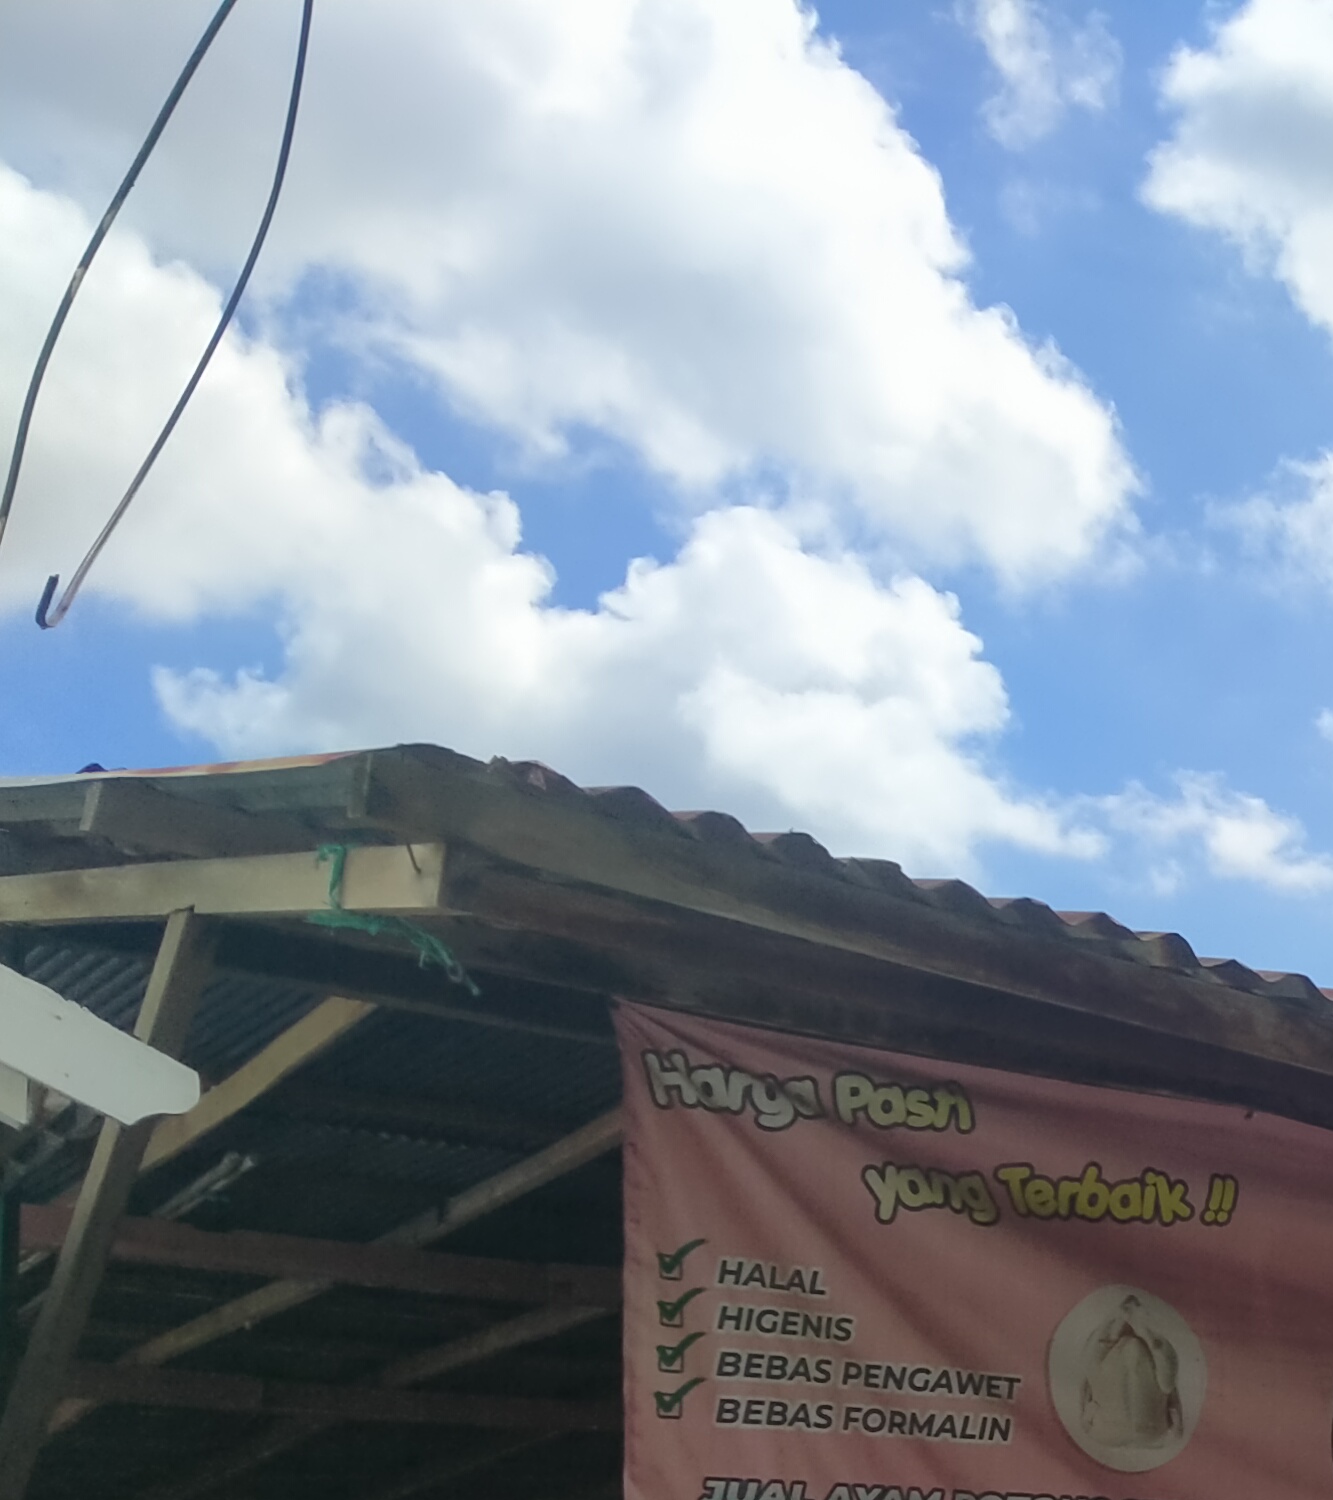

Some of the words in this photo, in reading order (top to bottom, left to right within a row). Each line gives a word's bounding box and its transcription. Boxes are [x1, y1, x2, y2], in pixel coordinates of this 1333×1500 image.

[641, 1048, 824, 1131] Harga
[861, 1162, 998, 1227] yang
[996, 1161, 1194, 1226] Terbaik
[717, 1259, 826, 1296] HALAL
[717, 1305, 854, 1342] HIGENIS
[716, 1350, 832, 1386] BEBAS
[840, 1361, 1022, 1402] PENGAWET
[715, 1397, 834, 1431] BEBAS
[841, 1405, 1011, 1443] FORMALIN
